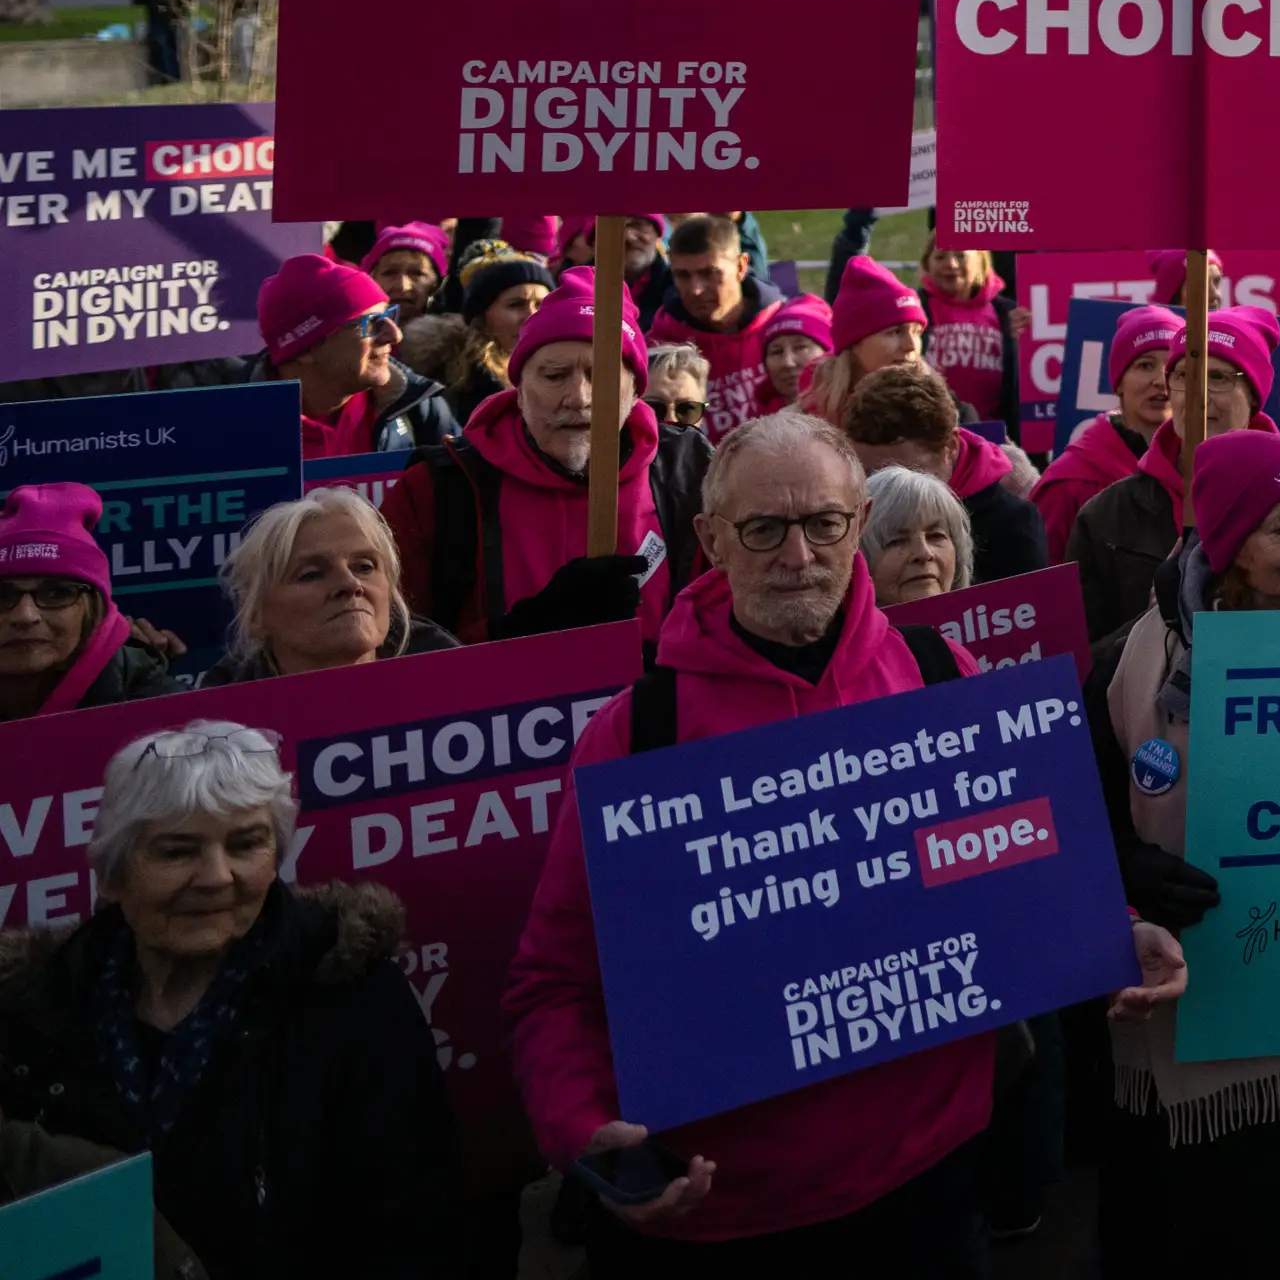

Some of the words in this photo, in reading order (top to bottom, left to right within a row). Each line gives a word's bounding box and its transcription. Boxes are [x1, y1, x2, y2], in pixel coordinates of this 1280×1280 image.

[0, 152, 55, 183] VE
[72, 147, 137, 179] ME
[152, 141, 274, 176] CHOIC
[0, 194, 69, 226] ER
[86, 188, 155, 221] MY
[170, 181, 274, 216] DEAT
[954, 209, 1028, 220] DIGNITY
[954, 221, 972, 232] IN
[975, 221, 1034, 232] DYING.
[13, 430, 140, 456] Humanists
[146, 427, 177, 446] UK
[143, 489, 246, 528] THE
[602, 793, 703, 843] Kim
[720, 722, 982, 815] Leadbeater
[996, 697, 1082, 746] MP:
[1138, 748, 1176, 775] HUMANIST
[351, 779, 561, 869] DEAT
[685, 810, 840, 876] Thank
[854, 788, 939, 841] you
[954, 766, 1018, 809] for
[690, 866, 841, 942] giving
[856, 851, 912, 888] us
[925, 816, 1050, 871] hope.
